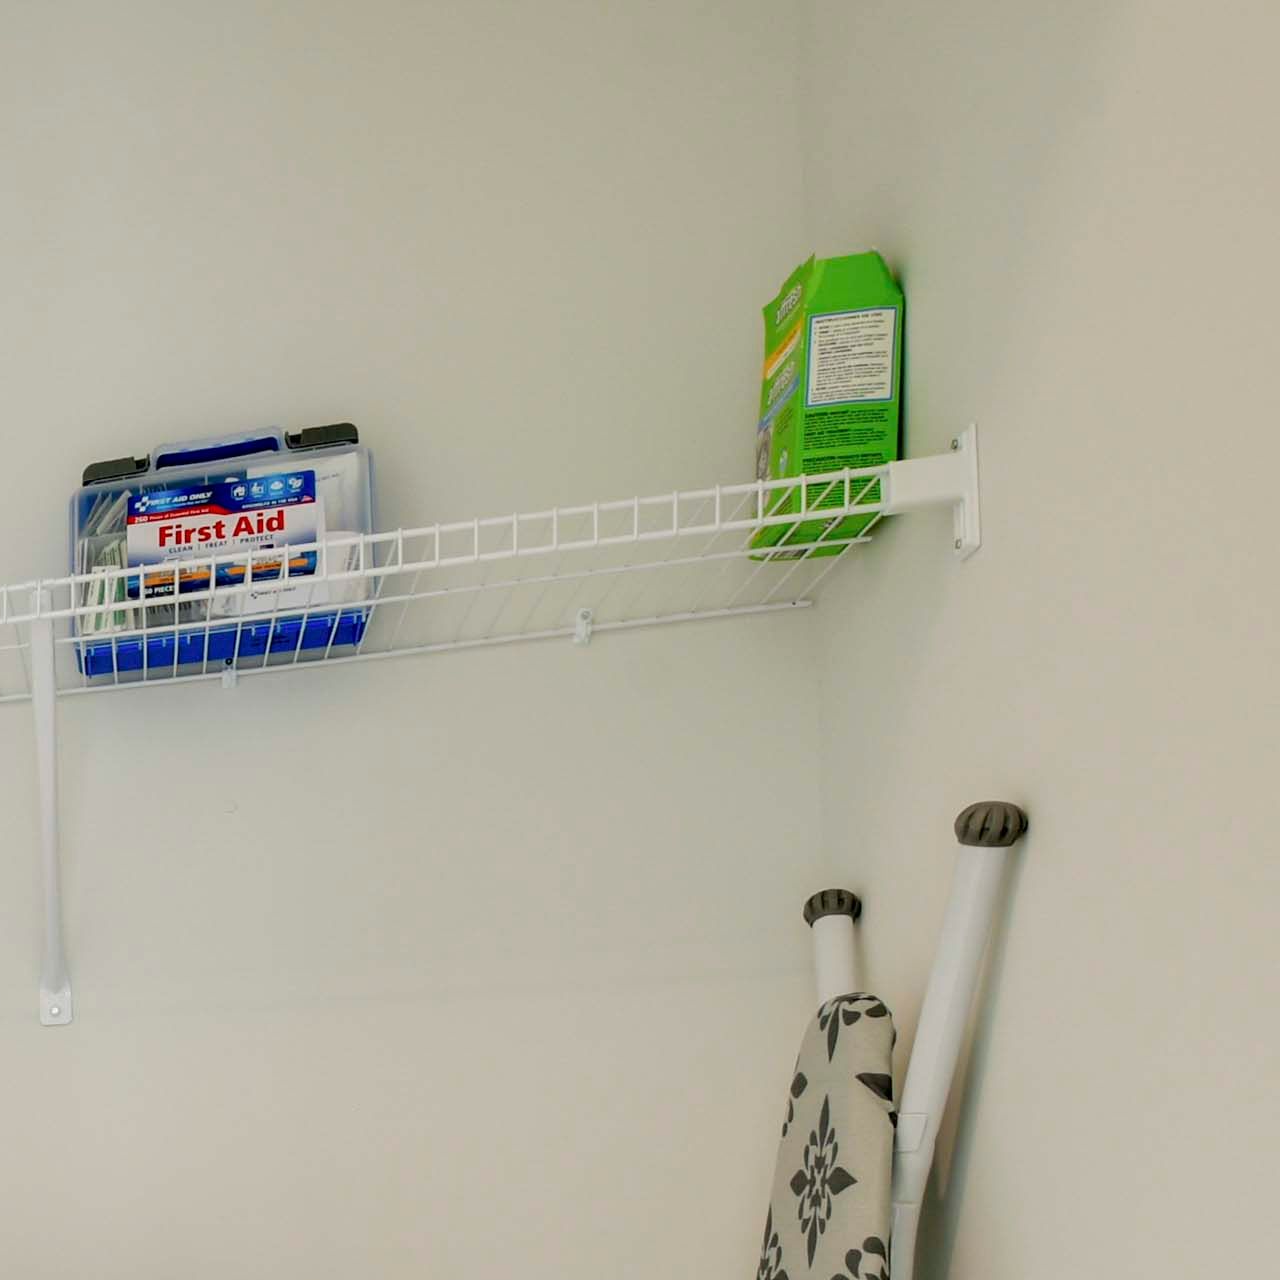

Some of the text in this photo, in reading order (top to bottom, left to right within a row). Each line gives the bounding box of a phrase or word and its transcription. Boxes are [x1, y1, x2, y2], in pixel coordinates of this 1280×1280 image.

[172, 495, 188, 503] AID
[189, 491, 213, 501] ONLY
[159, 510, 285, 547] First Aid
[169, 534, 274, 554] CLEAN TREAT PROTECT
